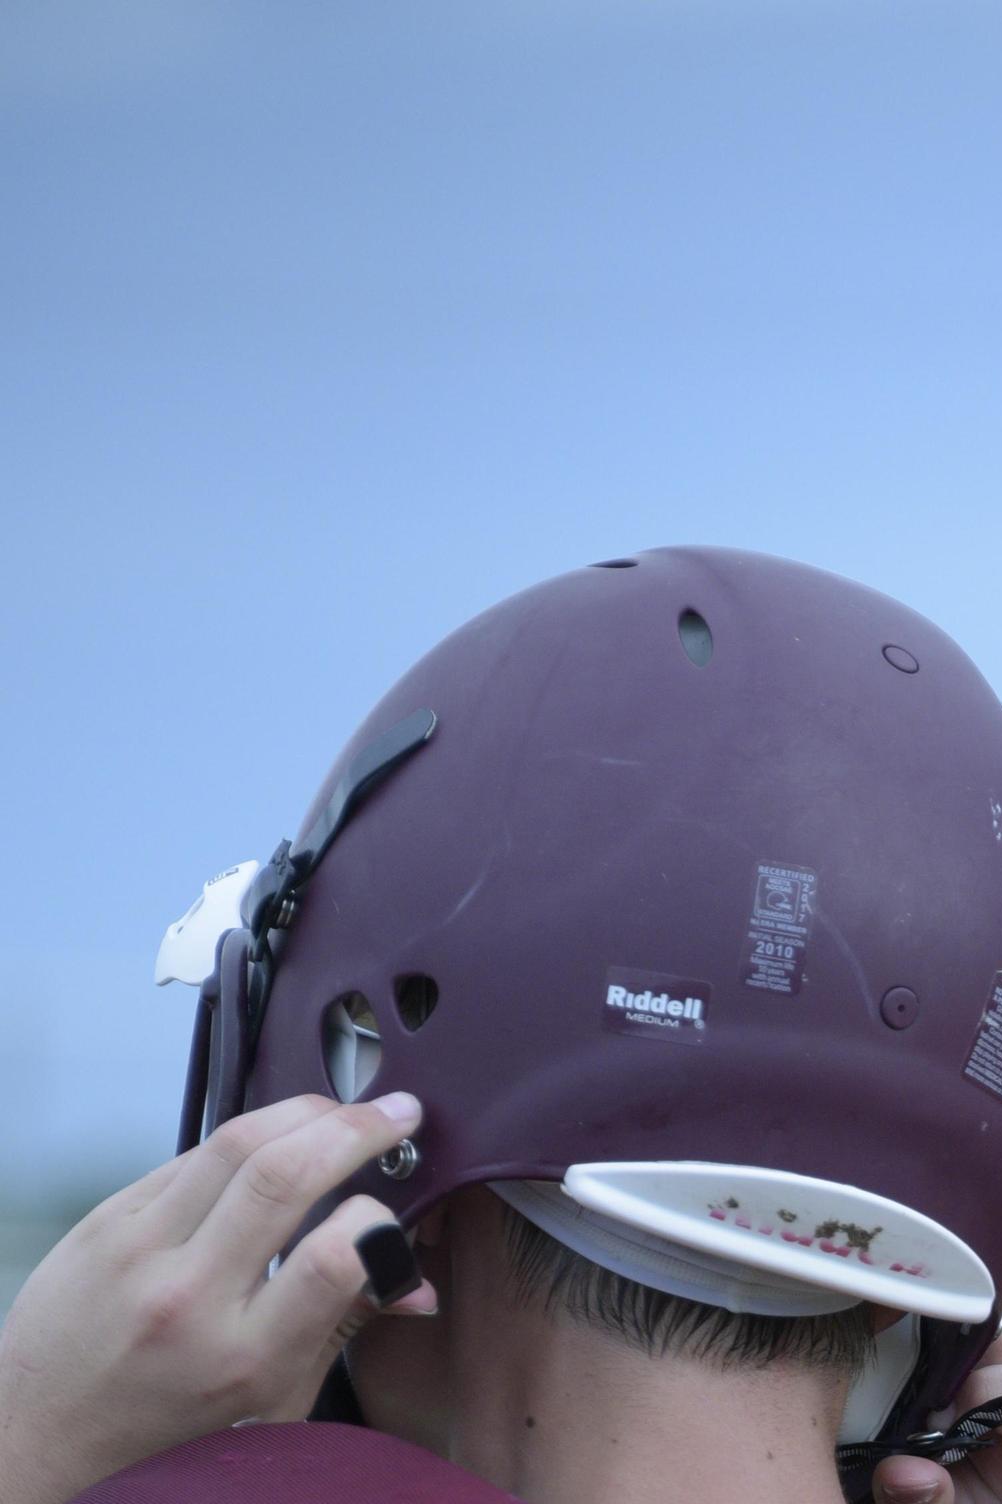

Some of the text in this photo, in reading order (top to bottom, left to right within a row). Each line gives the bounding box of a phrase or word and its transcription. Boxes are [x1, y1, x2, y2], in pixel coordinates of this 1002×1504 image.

[758, 865, 815, 882] RECERTIFIED
[755, 941, 794, 958] 2010
[606, 984, 702, 1020] Riddell
[625, 1011, 680, 1028] MEDIUM
